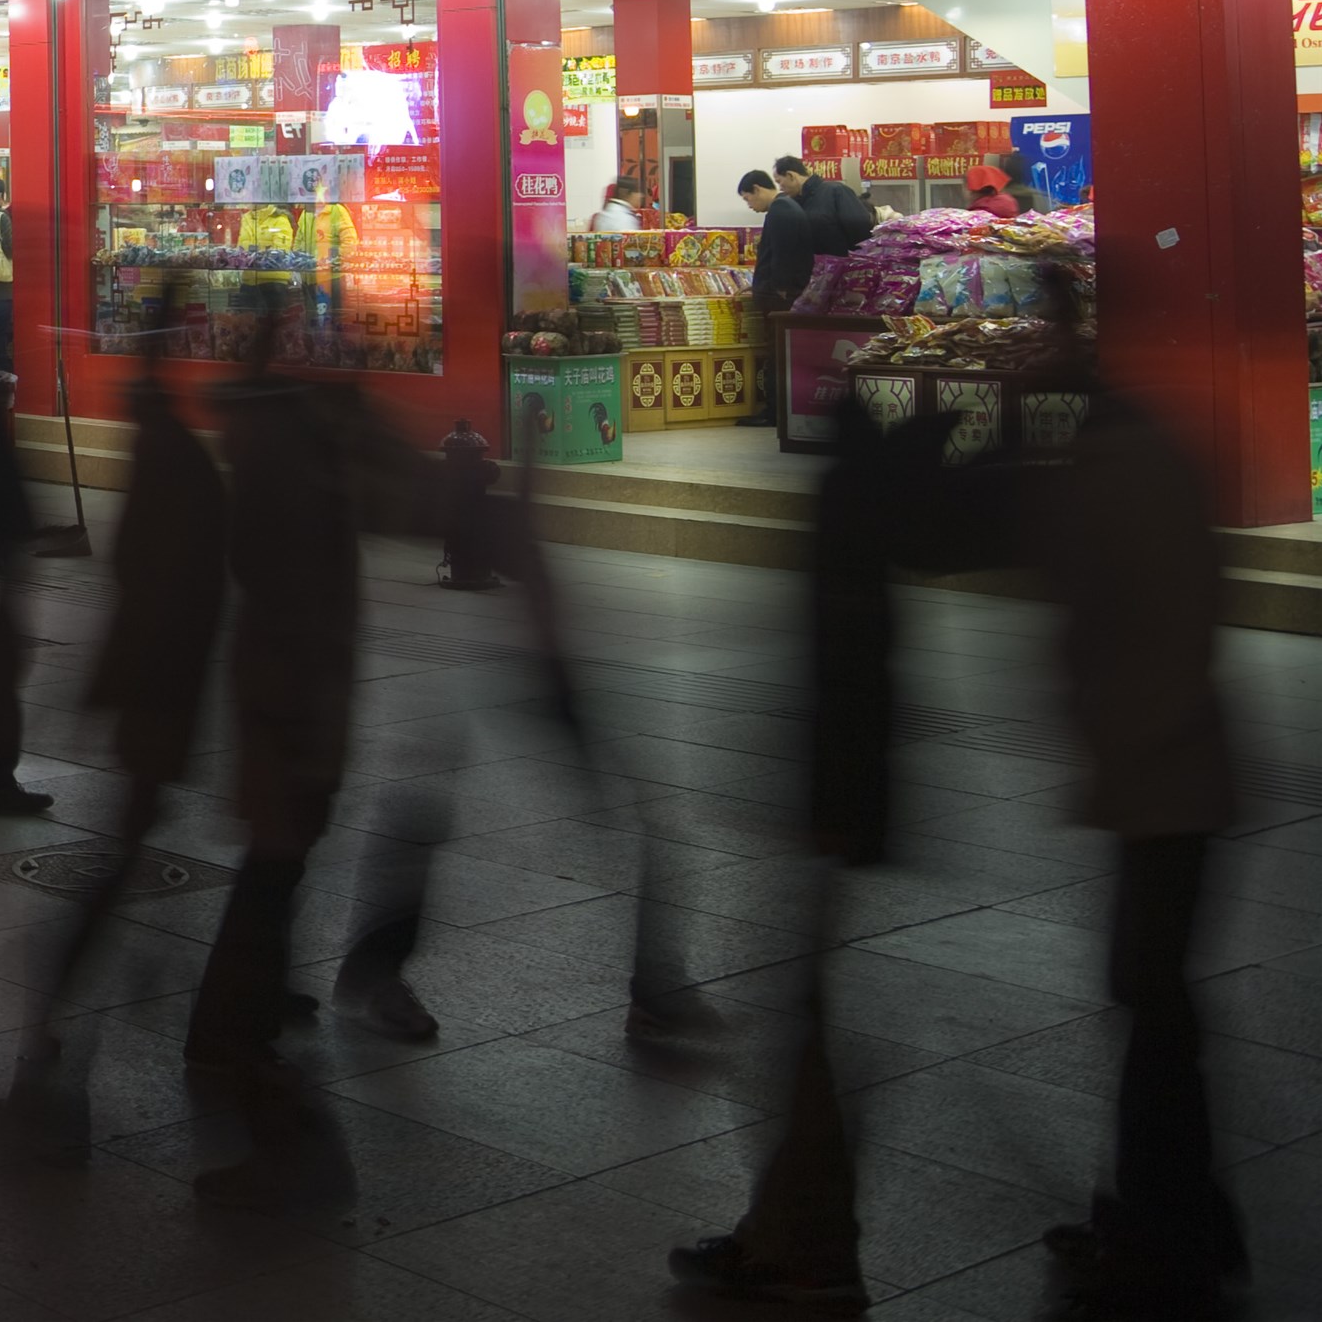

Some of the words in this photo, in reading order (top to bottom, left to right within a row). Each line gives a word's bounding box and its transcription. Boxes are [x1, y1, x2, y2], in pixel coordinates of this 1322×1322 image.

[387, 49, 421, 69] 招聘
[693, 61, 737, 75] 京特产
[876, 51, 942, 67] 南京盐水鸭
[1023, 122, 1072, 135] PEPSI
[863, 158, 914, 178] 免费品尝
[521, 175, 559, 195] 桂花鸭
